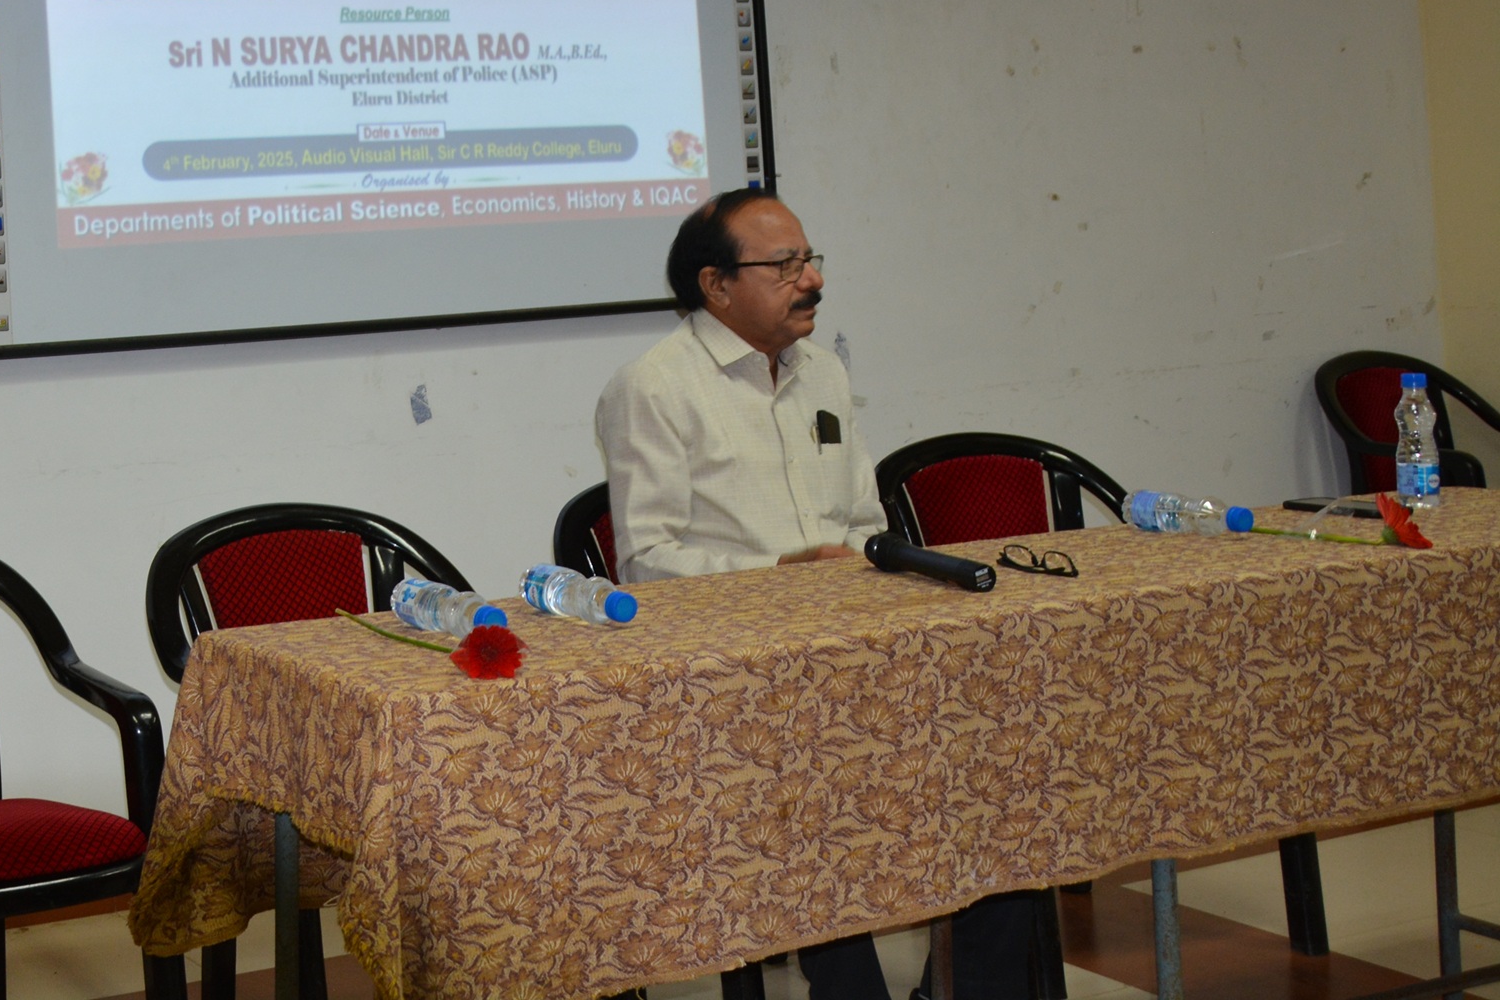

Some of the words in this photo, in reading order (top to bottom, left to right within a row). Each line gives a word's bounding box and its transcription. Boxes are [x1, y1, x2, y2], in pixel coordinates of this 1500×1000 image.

[340, 6, 402, 23] Resource
[405, 6, 450, 22] Person
[168, 40, 203, 68] Sri
[211, 37, 231, 67] N
[240, 36, 333, 67] SURYA
[340, 33, 471, 64] CHANDRA
[477, 32, 530, 62] RAO
[230, 69, 314, 88] Additional
[318, 67, 439, 89] Superintendent
[443, 66, 460, 83] of
[462, 65, 508, 83] Police
[512, 64, 558, 84] (ASP)
[352, 91, 393, 107] Eluru
[397, 90, 448, 105] District
[364, 125, 391, 139] Date
[402, 124, 440, 138] Venue
[183, 153, 254, 173] February,
[257, 152, 298, 169] 2025,
[301, 149, 346, 166] Audio
[350, 145, 395, 163] Visual
[401, 144, 433, 163] Hall,
[438, 144, 456, 160] Sir
[460, 144, 470, 159] C
[474, 144, 484, 158] R
[487, 142, 529, 160] Reddy
[532, 140, 585, 159] College,
[588, 139, 622, 155] Eluru
[361, 172, 430, 191] Organised
[435, 170, 450, 188] by
[74, 206, 214, 239] Departments
[221, 206, 242, 227] of
[248, 202, 343, 226] Political
[351, 199, 445, 220] Science,
[452, 191, 560, 216] Economics,
[567, 189, 626, 212] History
[633, 188, 644, 206] &
[651, 186, 698, 205] IQAC
